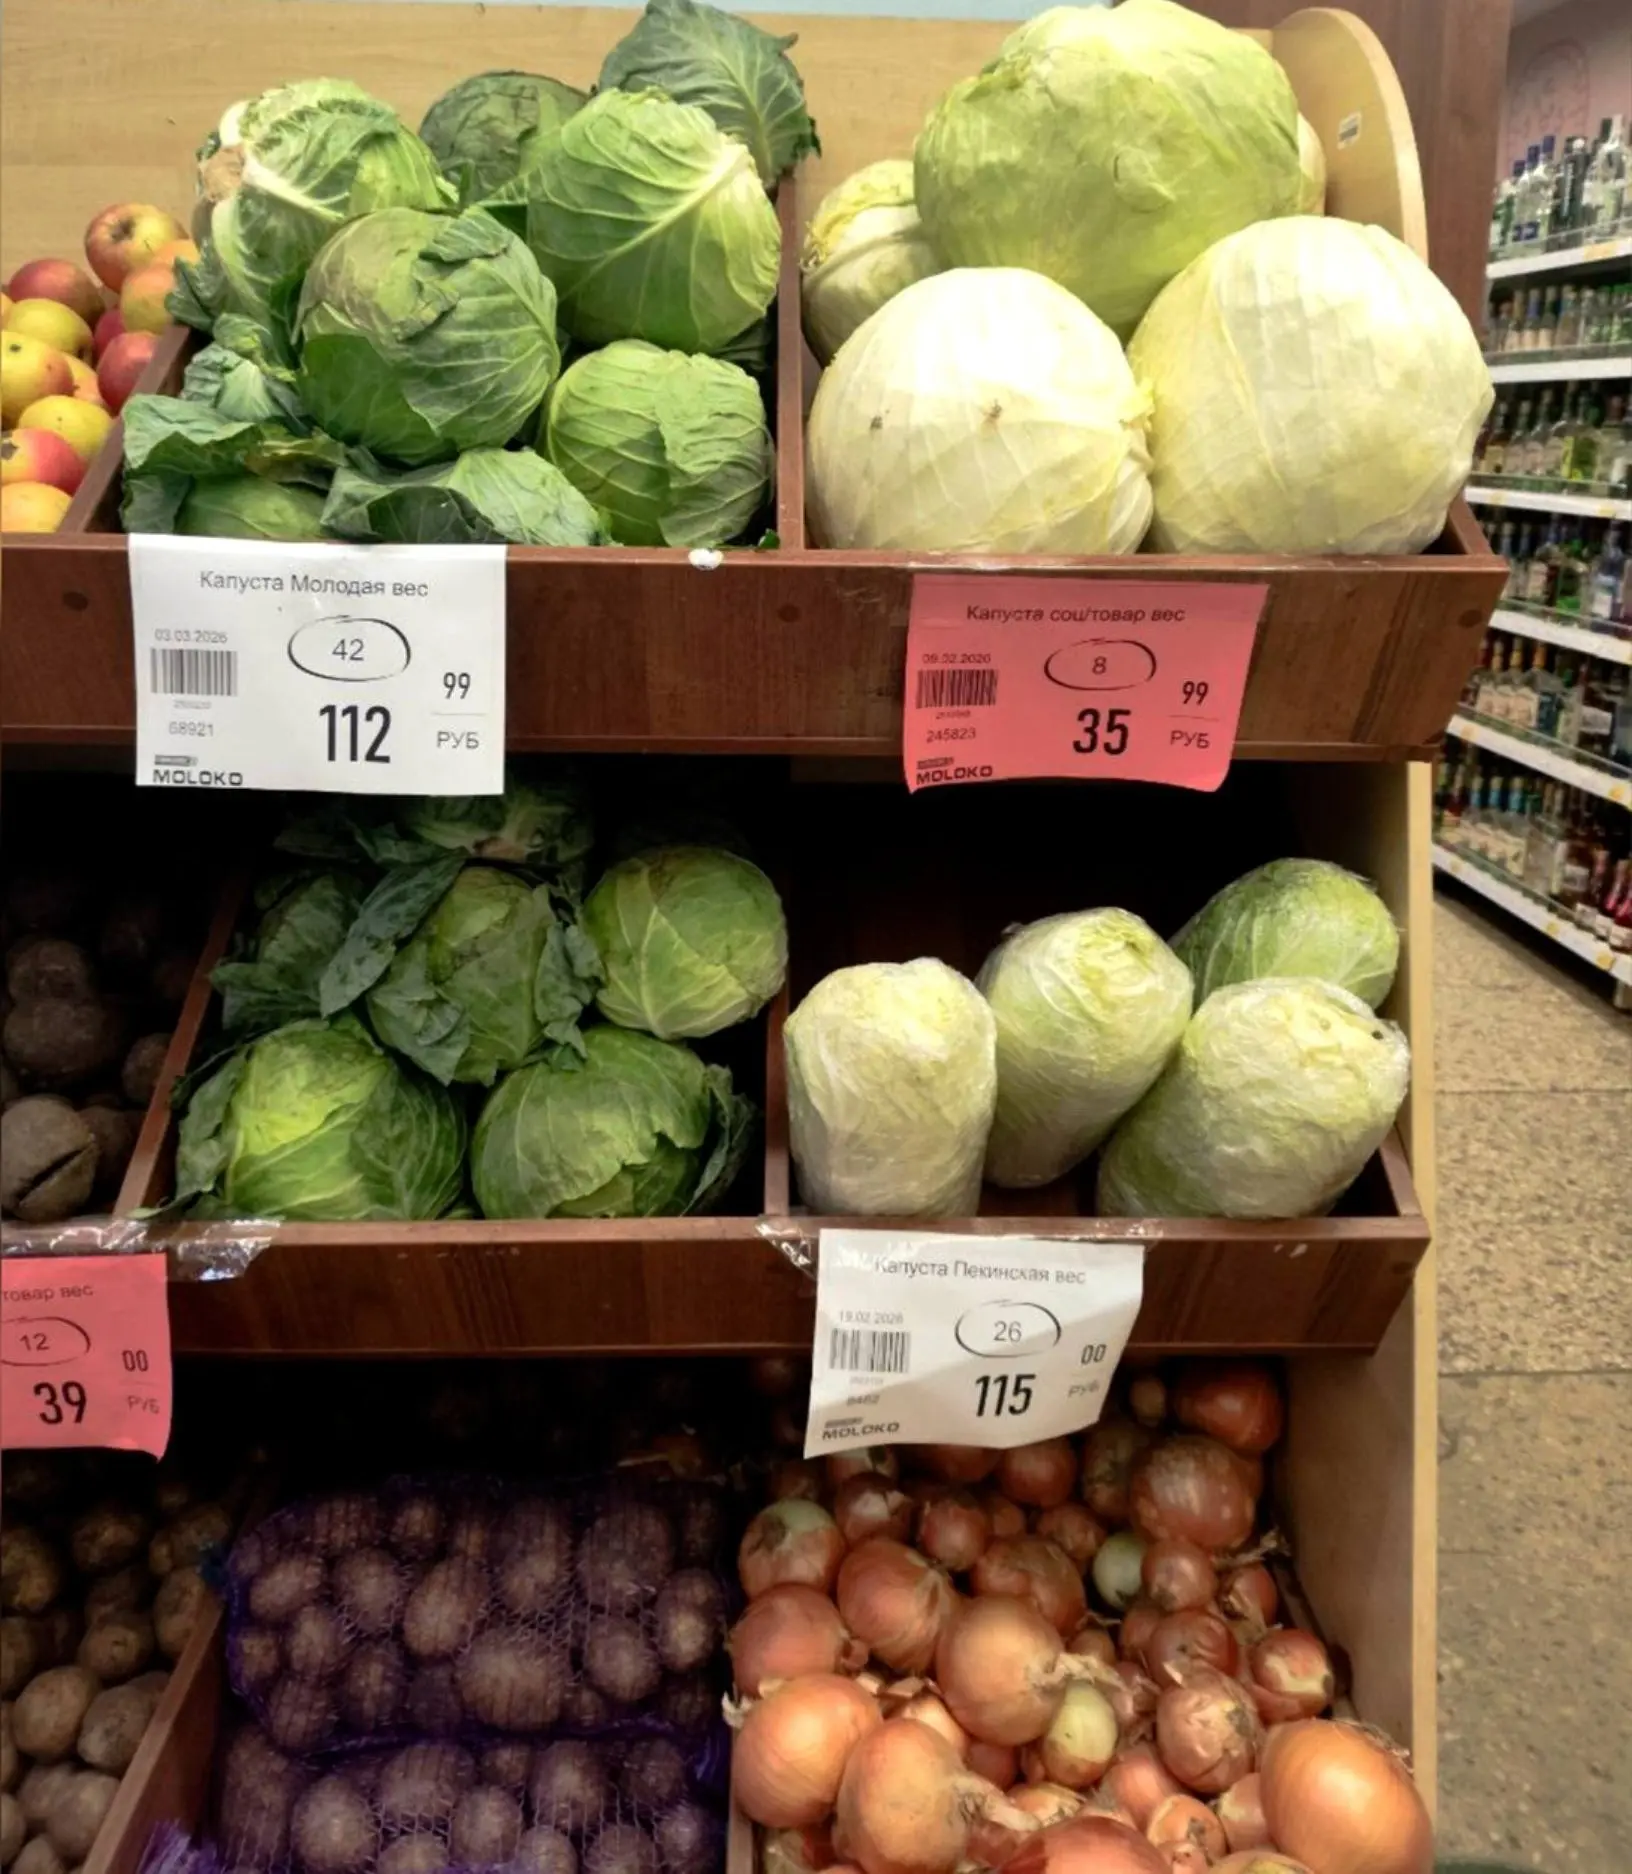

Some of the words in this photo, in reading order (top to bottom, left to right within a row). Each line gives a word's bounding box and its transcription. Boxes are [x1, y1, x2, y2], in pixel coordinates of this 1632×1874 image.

[200, 571, 284, 597] Капуста
[291, 574, 385, 597] Молодая
[392, 582, 429, 597] вес
[966, 605, 1043, 623] Капуста
[1050, 606, 1145, 624] соц/товар
[1151, 610, 1186, 623] вес
[332, 638, 364, 661] 42
[1092, 656, 1107, 675] 8
[443, 672, 471, 699] 99
[1182, 681, 1209, 706] 99
[169, 721, 214, 737] 68921
[319, 704, 391, 763] 112
[926, 727, 976, 744] 245823
[1072, 708, 1132, 755] 35
[436, 731, 480, 749] РУБ
[1170, 730, 1210, 749] РУБ
[153, 769, 243, 786] MOLOKO
[916, 765, 993, 785] MOLOKO
[875, 1258, 948, 1280] Капуста
[953, 1261, 1050, 1283] Пекинская
[1055, 1270, 1086, 1285] вес
[60, 1285, 94, 1298] вес
[993, 1320, 1022, 1342] 26
[19, 1333, 50, 1351] 12
[121, 1350, 149, 1372] 00
[1080, 1344, 1107, 1365] 00
[33, 1381, 87, 1425] 39
[127, 1395, 160, 1414] РУБ
[975, 1373, 1036, 1418] 115
[822, 1422, 900, 1440] MOLOKO
